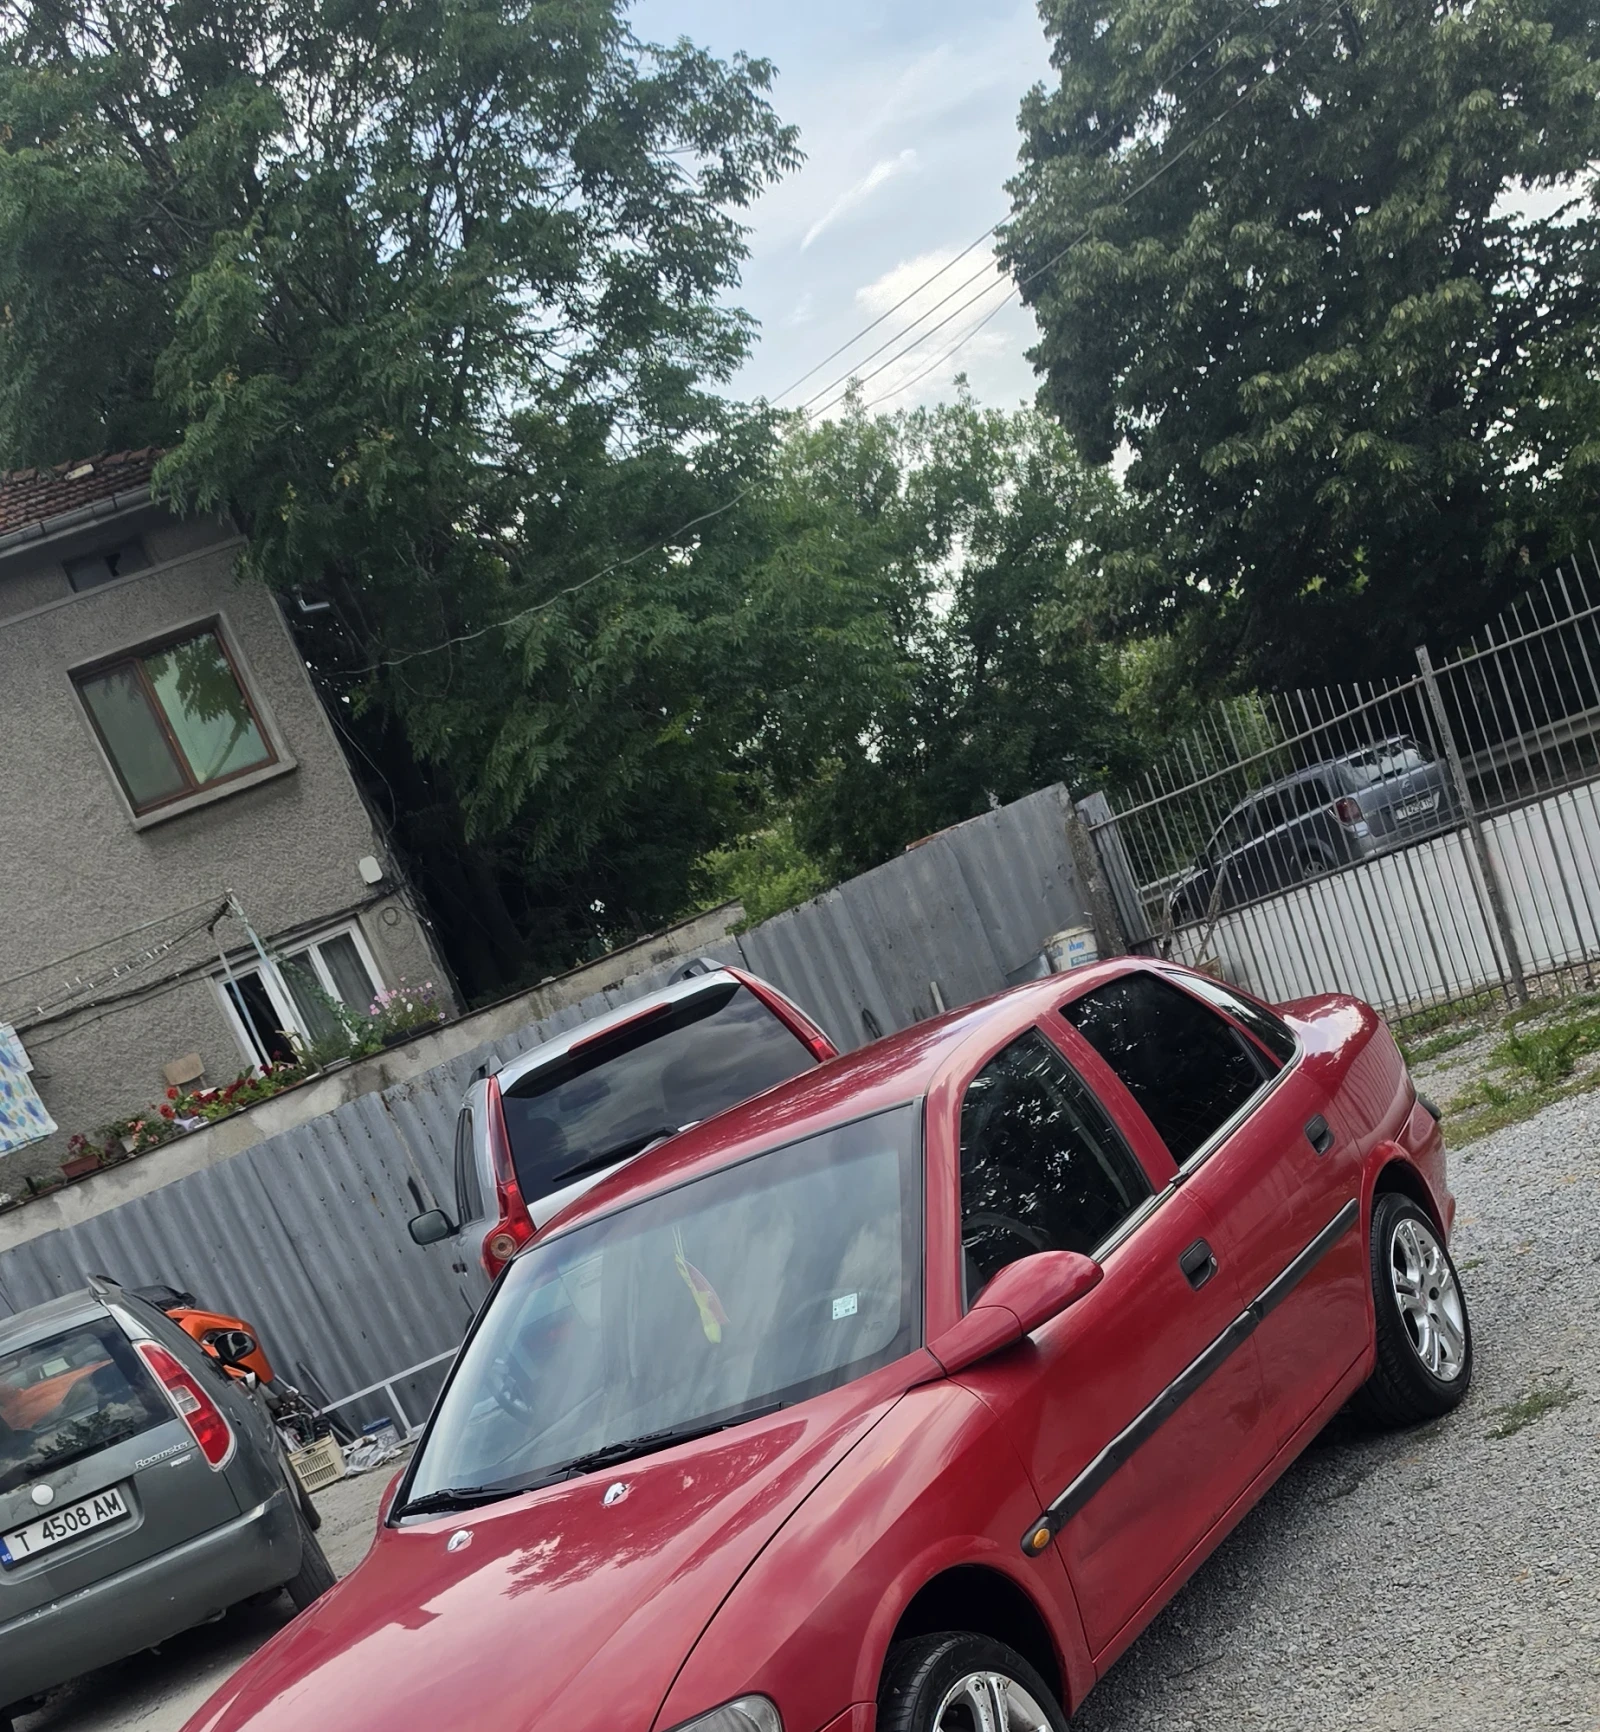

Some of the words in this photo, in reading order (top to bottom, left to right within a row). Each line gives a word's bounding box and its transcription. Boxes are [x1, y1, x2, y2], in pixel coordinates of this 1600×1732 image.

[135, 1440, 189, 1469] Roomster
[14, 1530, 30, 1552] T
[42, 1507, 91, 1541] 4508
[93, 1492, 122, 1521] AM
